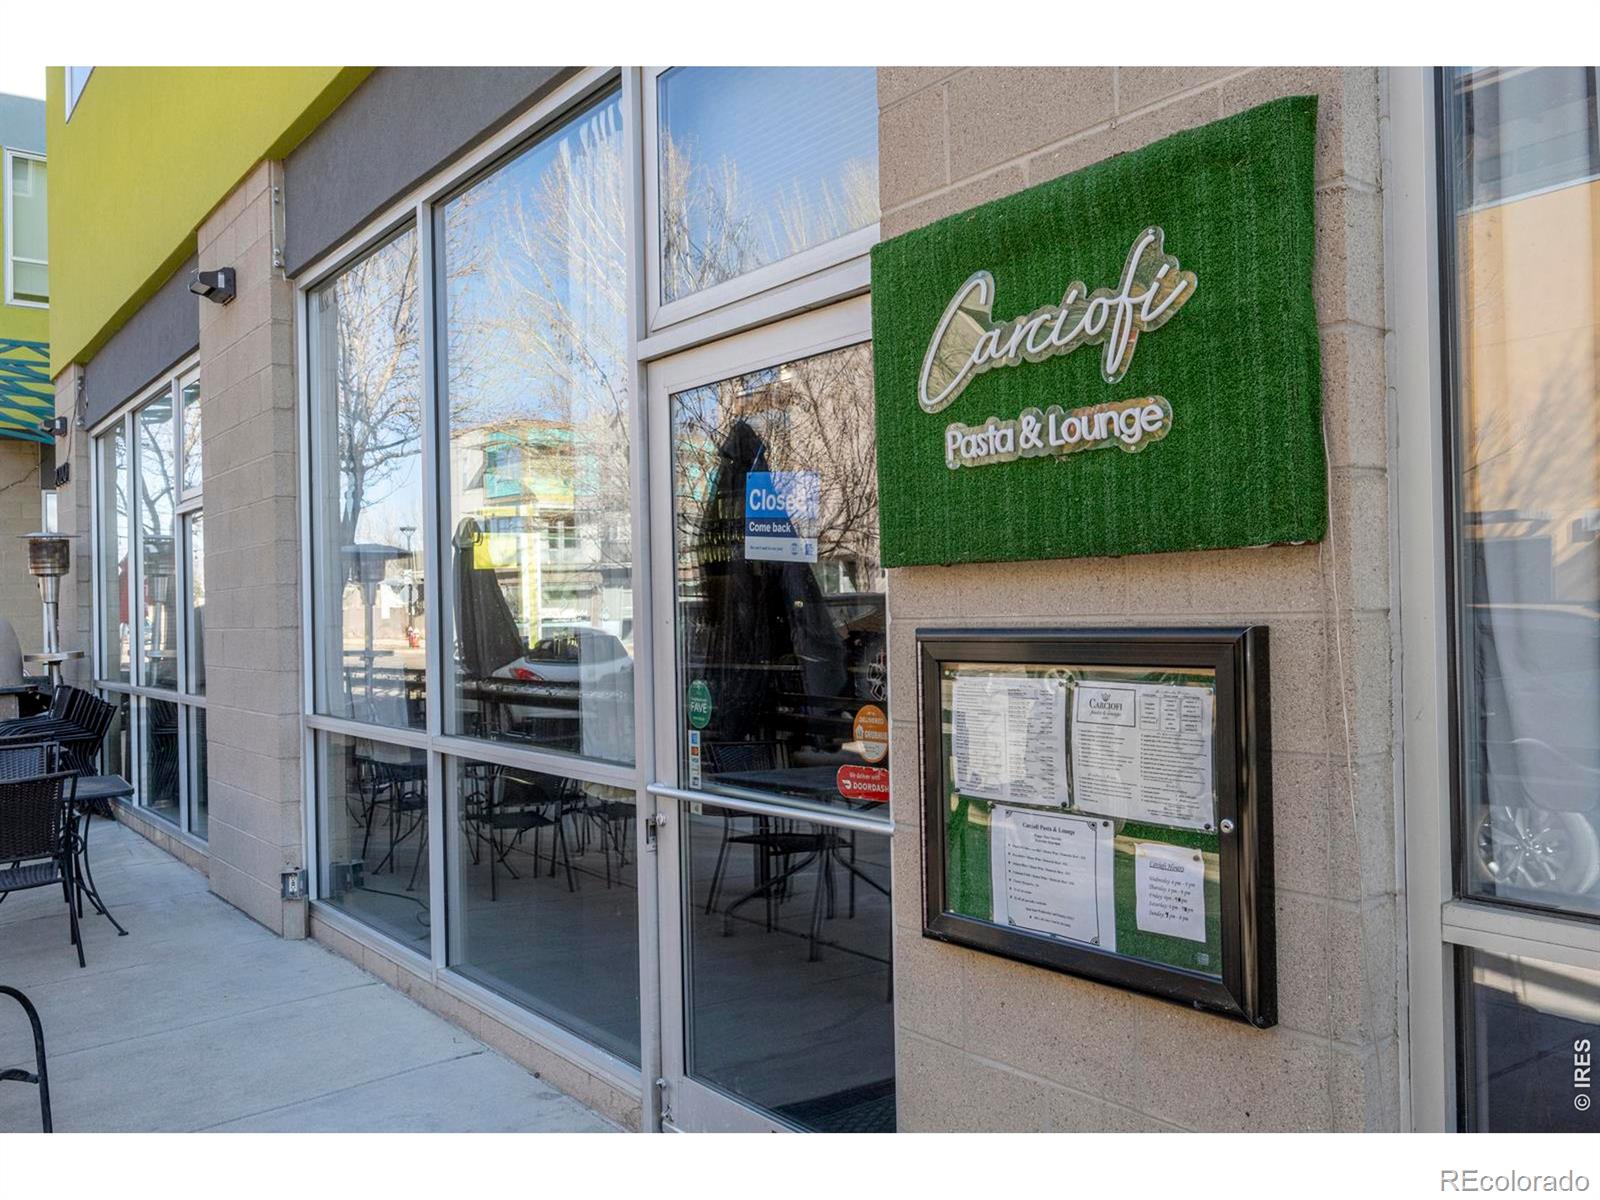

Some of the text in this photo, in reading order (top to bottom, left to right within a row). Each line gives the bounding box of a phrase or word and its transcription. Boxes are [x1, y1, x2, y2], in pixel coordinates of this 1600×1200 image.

[920, 233, 1188, 405] Carciofi
[946, 404, 1164, 461] Pasta & Lounge
[749, 521, 771, 533] Come
[772, 522, 792, 533] back
[690, 702, 708, 713] FAVE
